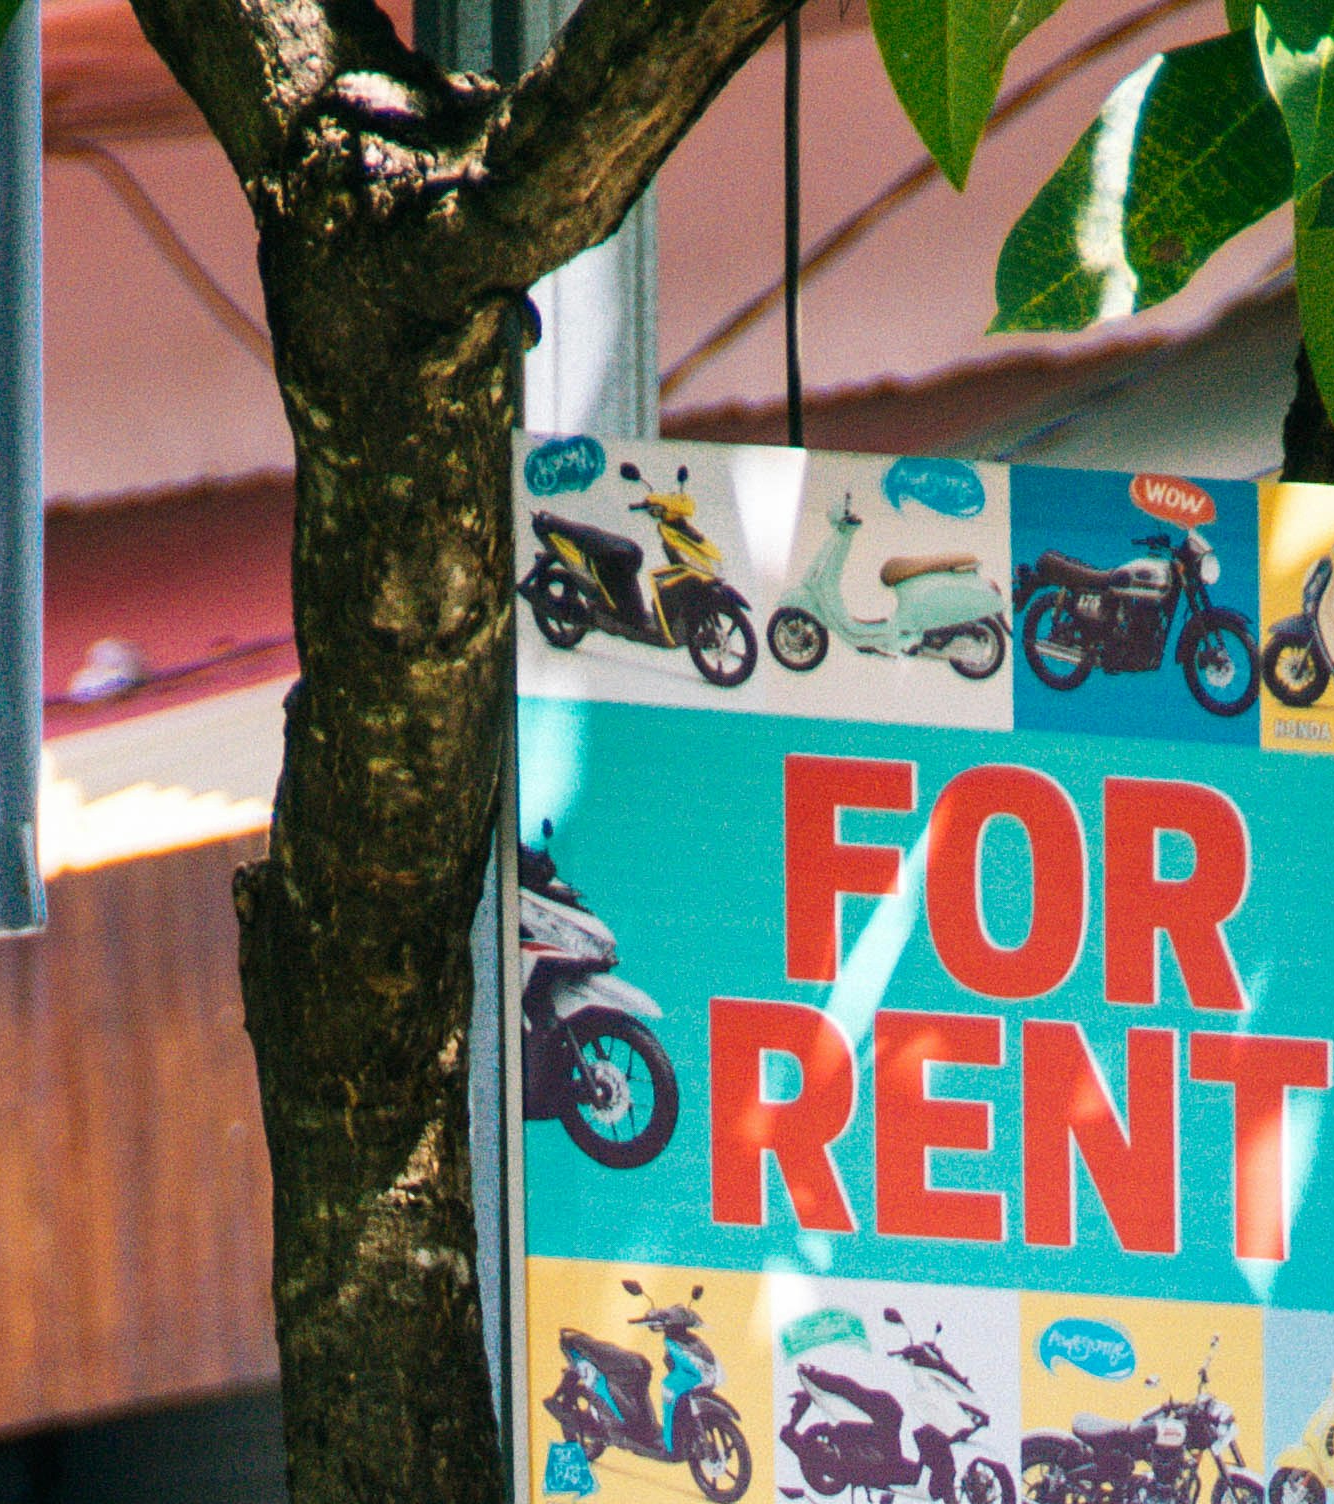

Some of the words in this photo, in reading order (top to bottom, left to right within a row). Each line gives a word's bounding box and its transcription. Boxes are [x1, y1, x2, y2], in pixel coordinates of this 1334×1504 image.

[1145, 478, 1207, 514] WOW
[1273, 719, 1331, 741] HONDA
[783, 753, 1252, 1013] FOR
[709, 997, 1334, 1264] RENT
